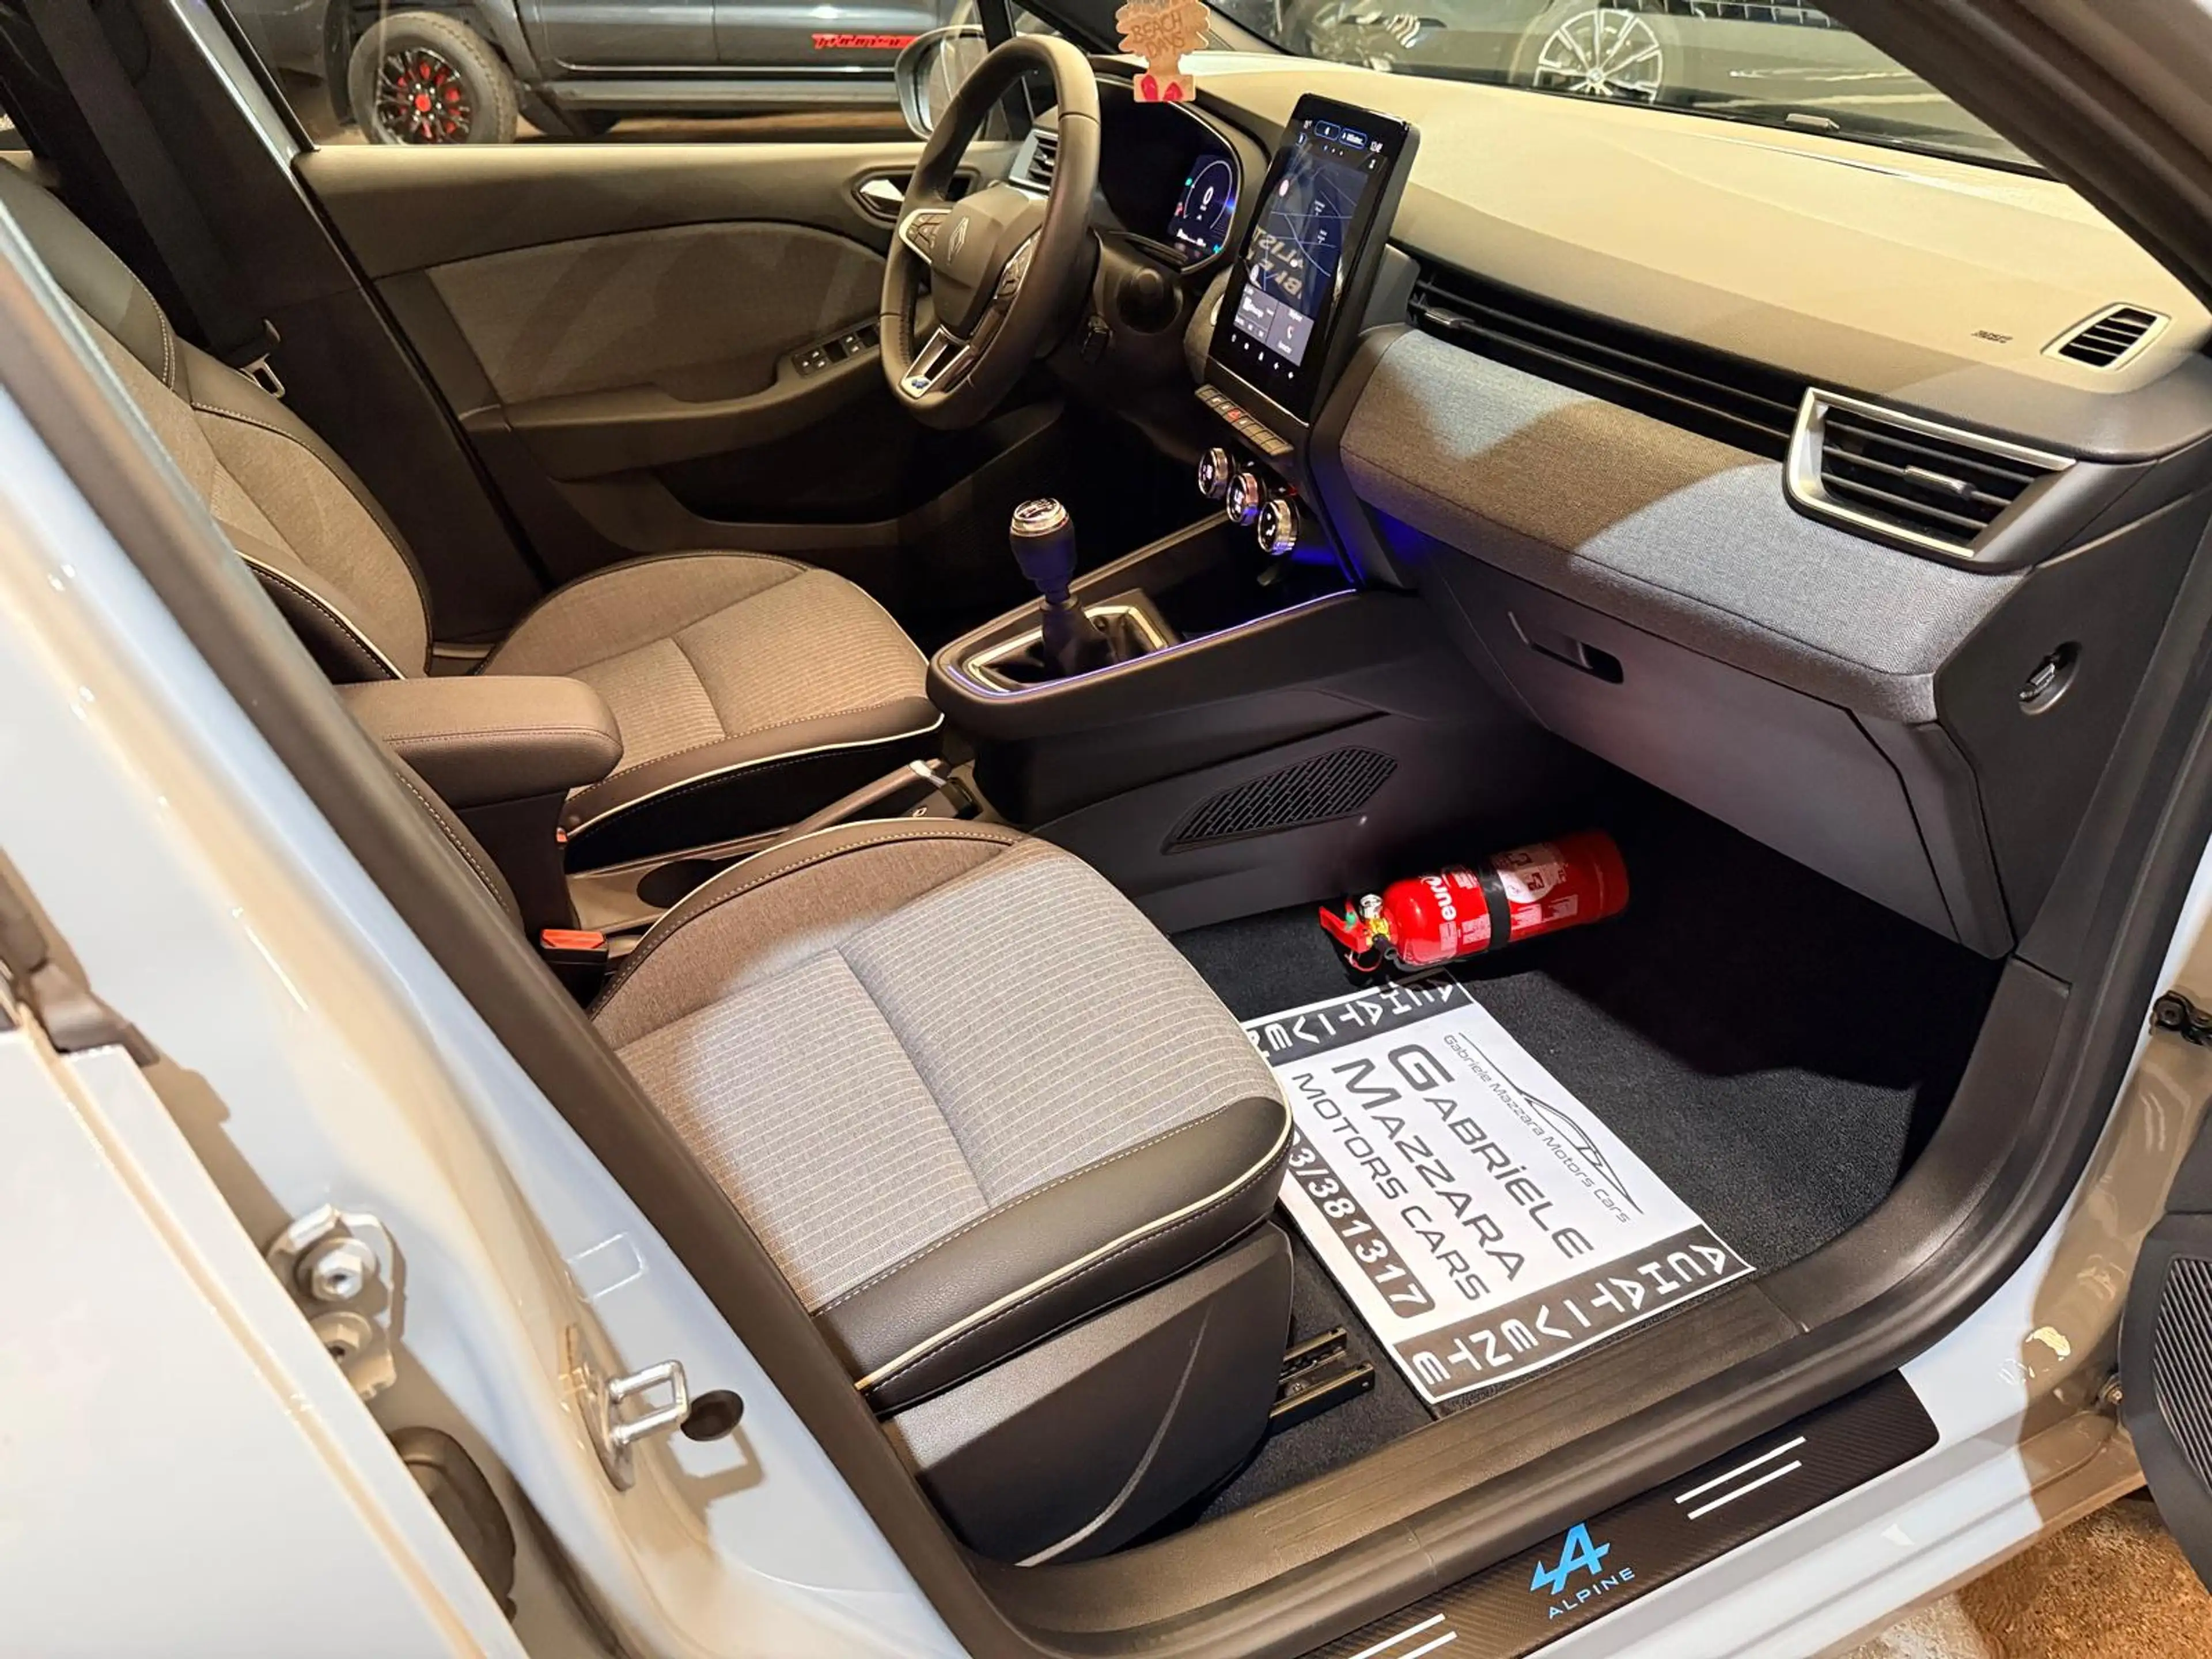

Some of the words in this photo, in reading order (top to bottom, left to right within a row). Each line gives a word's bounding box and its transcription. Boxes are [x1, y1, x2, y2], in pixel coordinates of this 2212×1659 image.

[1131, 11, 1183, 43] BEACH
[1145, 32, 1184, 59] DAYS
[1293, 1074, 1407, 1199] MOTORS
[1401, 1206, 1489, 1299] CARS
[1332, 1059, 1524, 1280] MAZZARA
[1444, 1034, 1493, 1082] Gabriele
[1492, 1083, 1544, 1136] Mazzara
[1544, 1137, 1594, 1188] Motors
[1594, 1190, 1631, 1224] Cars
[1548, 1567, 1636, 1619] ALPINE
